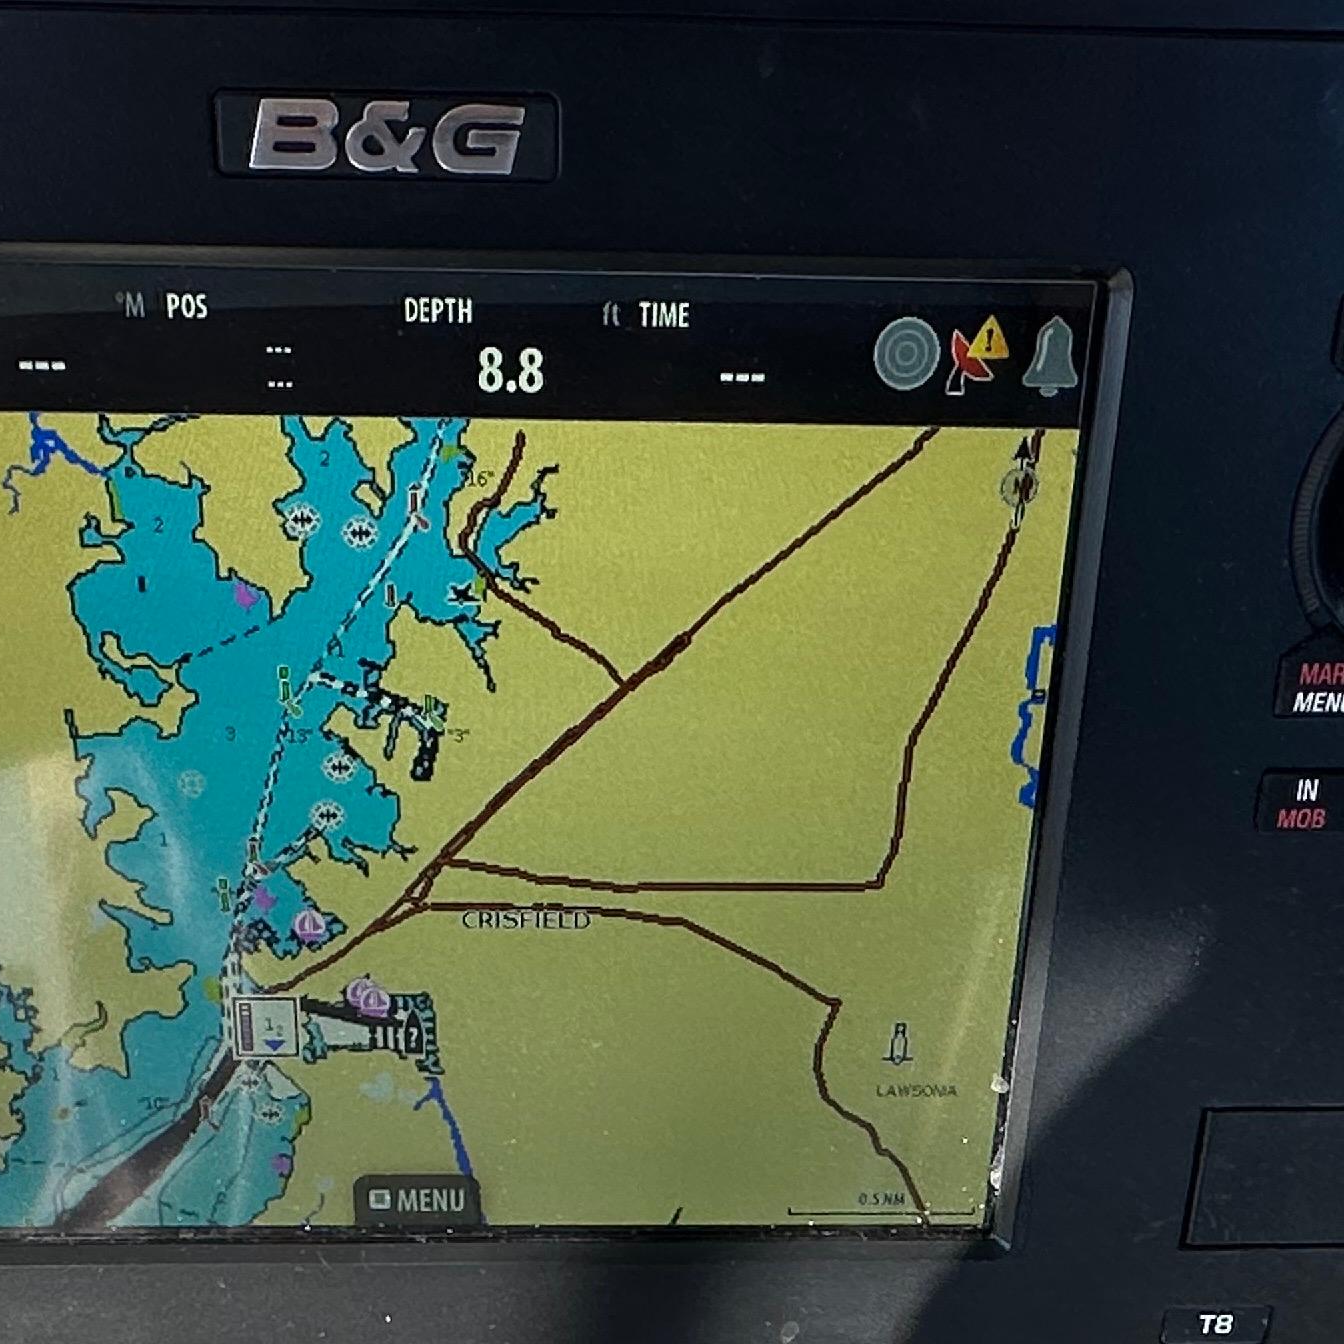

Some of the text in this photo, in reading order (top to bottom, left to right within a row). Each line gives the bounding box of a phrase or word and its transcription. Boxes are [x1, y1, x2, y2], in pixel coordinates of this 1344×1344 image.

[249, 98, 526, 176] B&G
[166, 292, 209, 320] POS
[404, 297, 474, 325] DEPTH
[638, 301, 690, 328] TIME
[477, 346, 545, 394] 8.8
[1296, 778, 1320, 802] IN
[1276, 808, 1327, 830] MOB
[461, 909, 592, 930] CRISFIELD
[397, 1188, 465, 1212] MENU
[1199, 1314, 1234, 1335] T8
